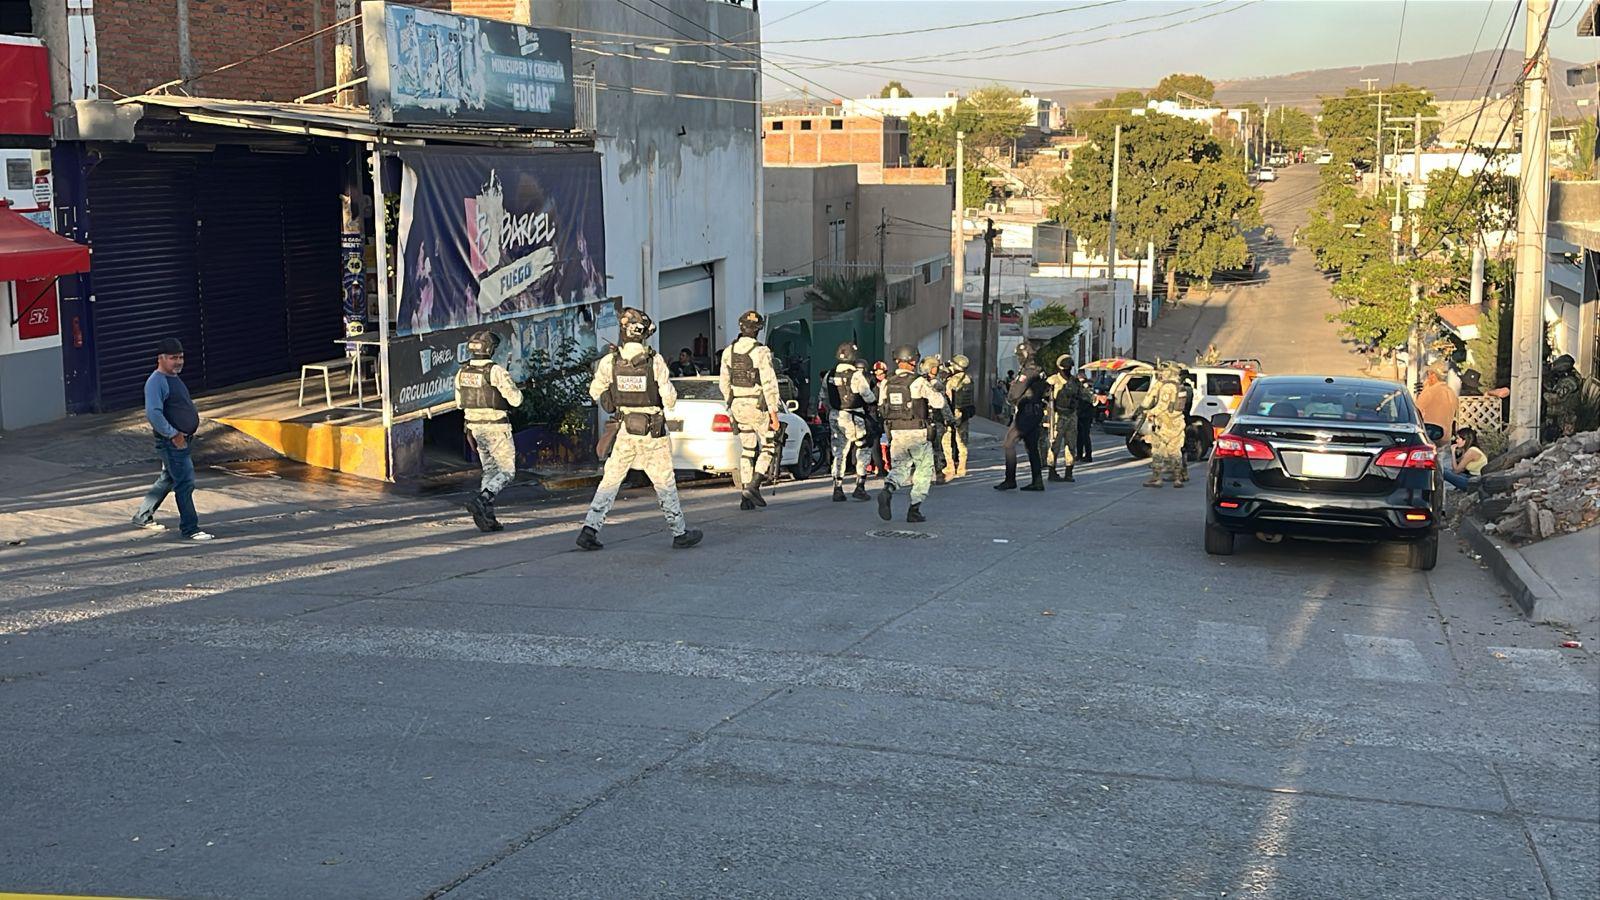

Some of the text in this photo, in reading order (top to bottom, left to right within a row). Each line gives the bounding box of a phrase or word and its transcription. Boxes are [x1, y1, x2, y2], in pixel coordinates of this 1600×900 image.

[491, 57, 528, 76] MINISUPER
[500, 209, 556, 250] BARCEL
[500, 262, 532, 294] FUEGO
